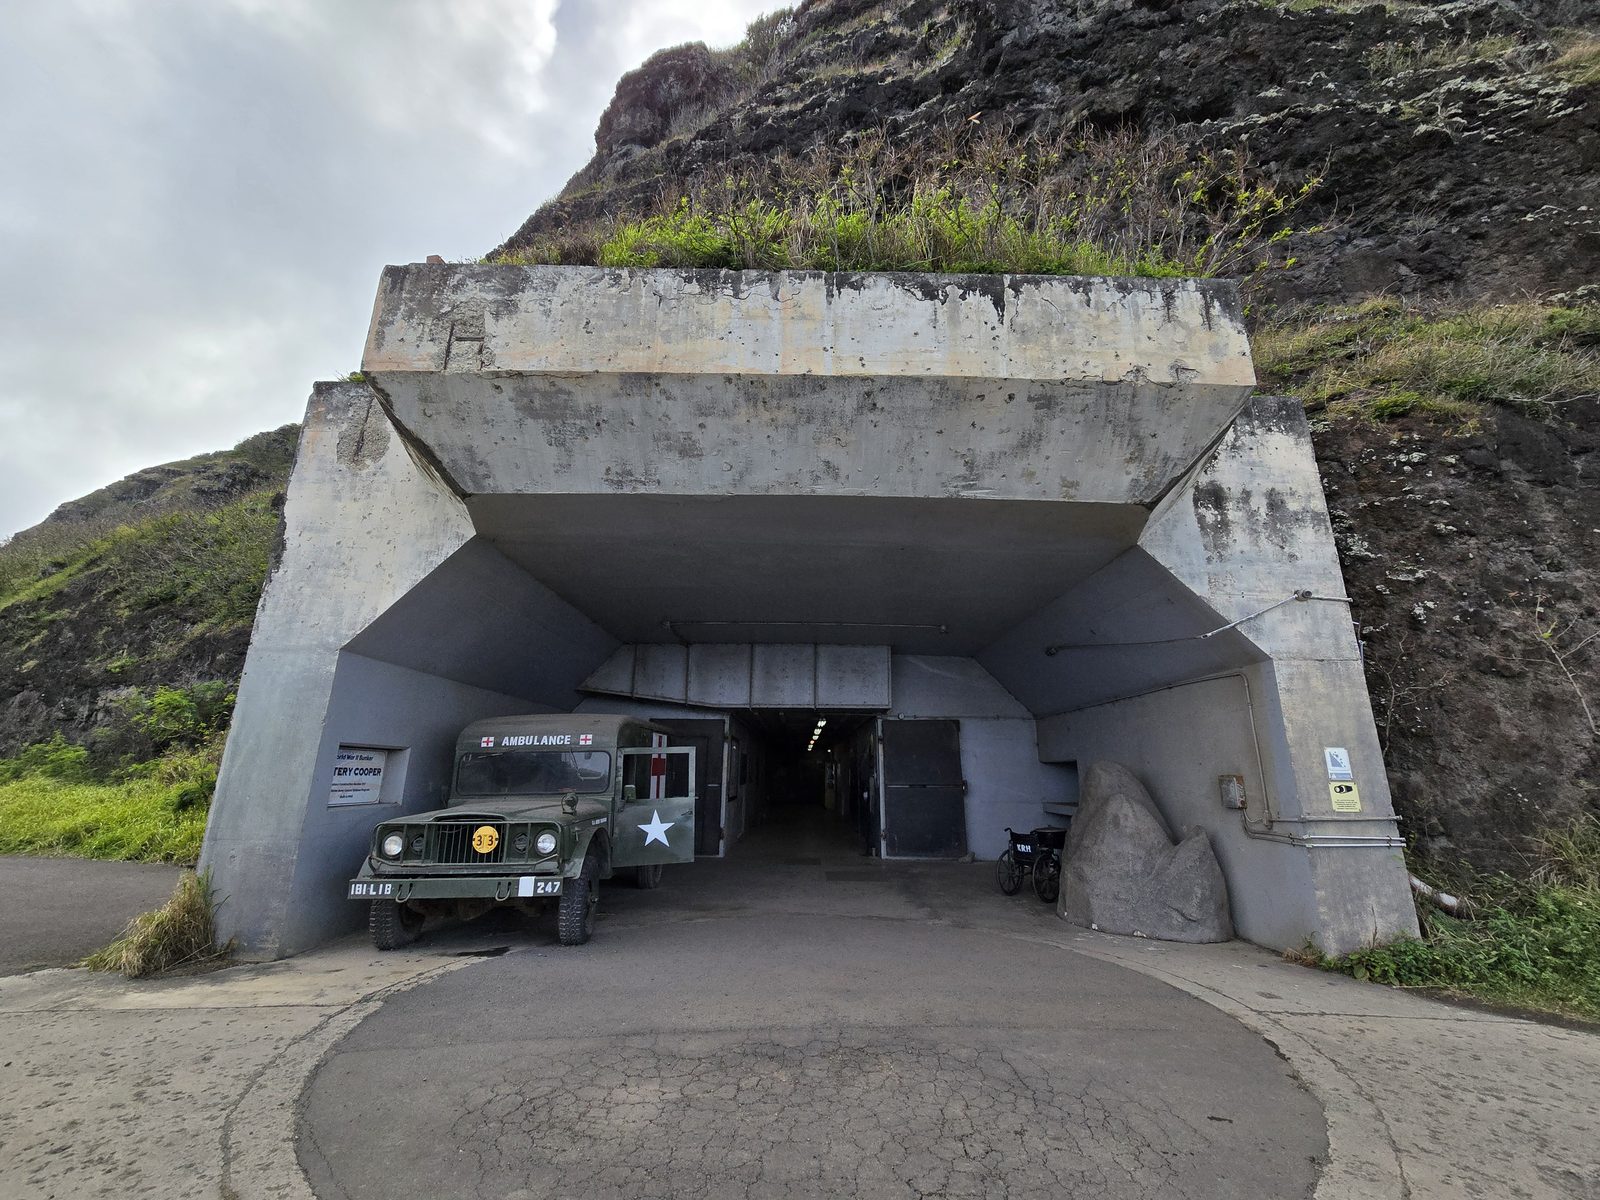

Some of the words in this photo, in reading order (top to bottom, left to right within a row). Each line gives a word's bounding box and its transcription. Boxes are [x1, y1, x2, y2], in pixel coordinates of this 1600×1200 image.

[501, 735, 571, 746] AMBULANCE
[353, 767, 382, 777] COOPER
[536, 881, 561, 894] 247
